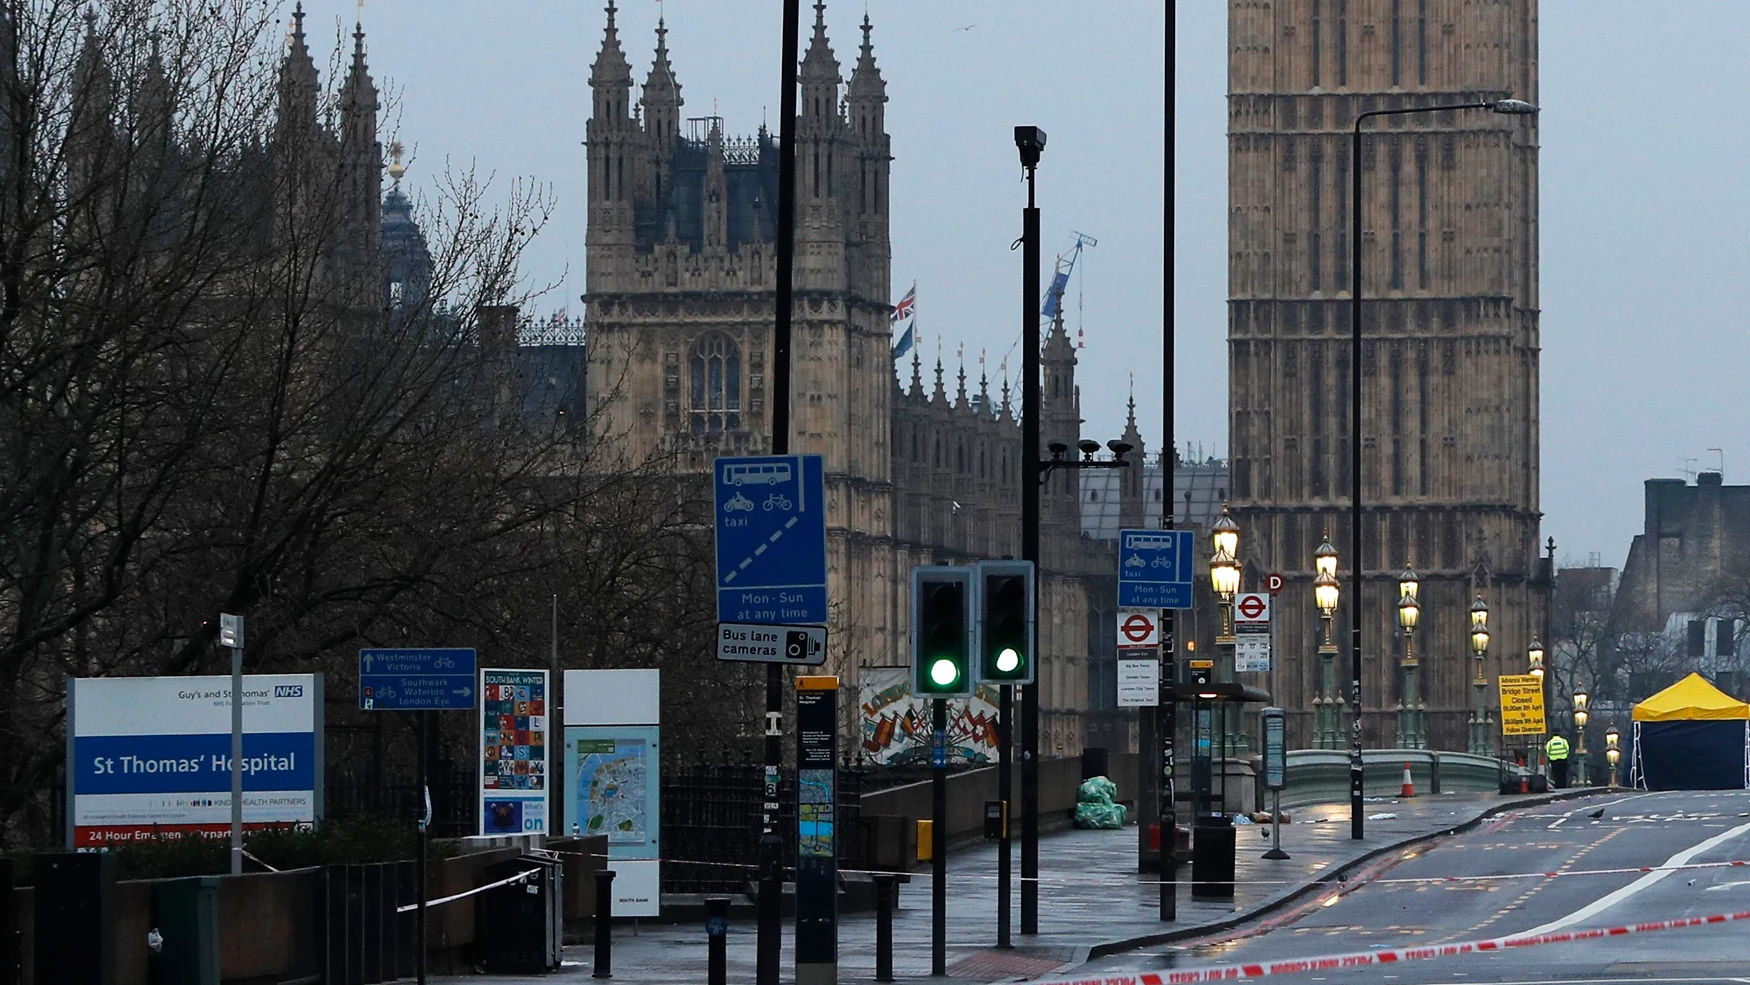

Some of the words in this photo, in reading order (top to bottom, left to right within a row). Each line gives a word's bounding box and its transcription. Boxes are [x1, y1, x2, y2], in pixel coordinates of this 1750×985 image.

[724, 517, 748, 527] taxi
[1270, 576, 1281, 589] D
[742, 594, 769, 604] Mon
[780, 593, 803, 603] Sun
[738, 611, 750, 619] at
[755, 611, 776, 621] any
[781, 608, 808, 618] time
[723, 629, 747, 641] Bus
[751, 630, 778, 642] lane
[723, 645, 777, 656] cameras
[376, 653, 431, 661] Westminster
[387, 663, 420, 671] Victoria
[401, 678, 448, 687] Southwark
[486, 676, 505, 684] SOUTH
[507, 676, 521, 685] BANK
[523, 676, 543, 685] WINTER
[179, 690, 201, 700] Guy's
[204, 690, 220, 699] and
[223, 690, 232, 698] St
[240, 689, 270, 698] homas'
[275, 686, 302, 697] NHS
[404, 688, 445, 696] Waterloo
[1502, 688, 1521, 696] Bridge
[435, 698, 450, 706] Eye
[862, 681, 911, 718] LONDO
[94, 757, 114, 774] St
[120, 755, 205, 774] Thomas'
[212, 752, 295, 776] Hospital
[767, 784, 775, 794] 6
[525, 818, 543, 830] on
[89, 831, 102, 841] 24
[106, 831, 132, 840] Hour
